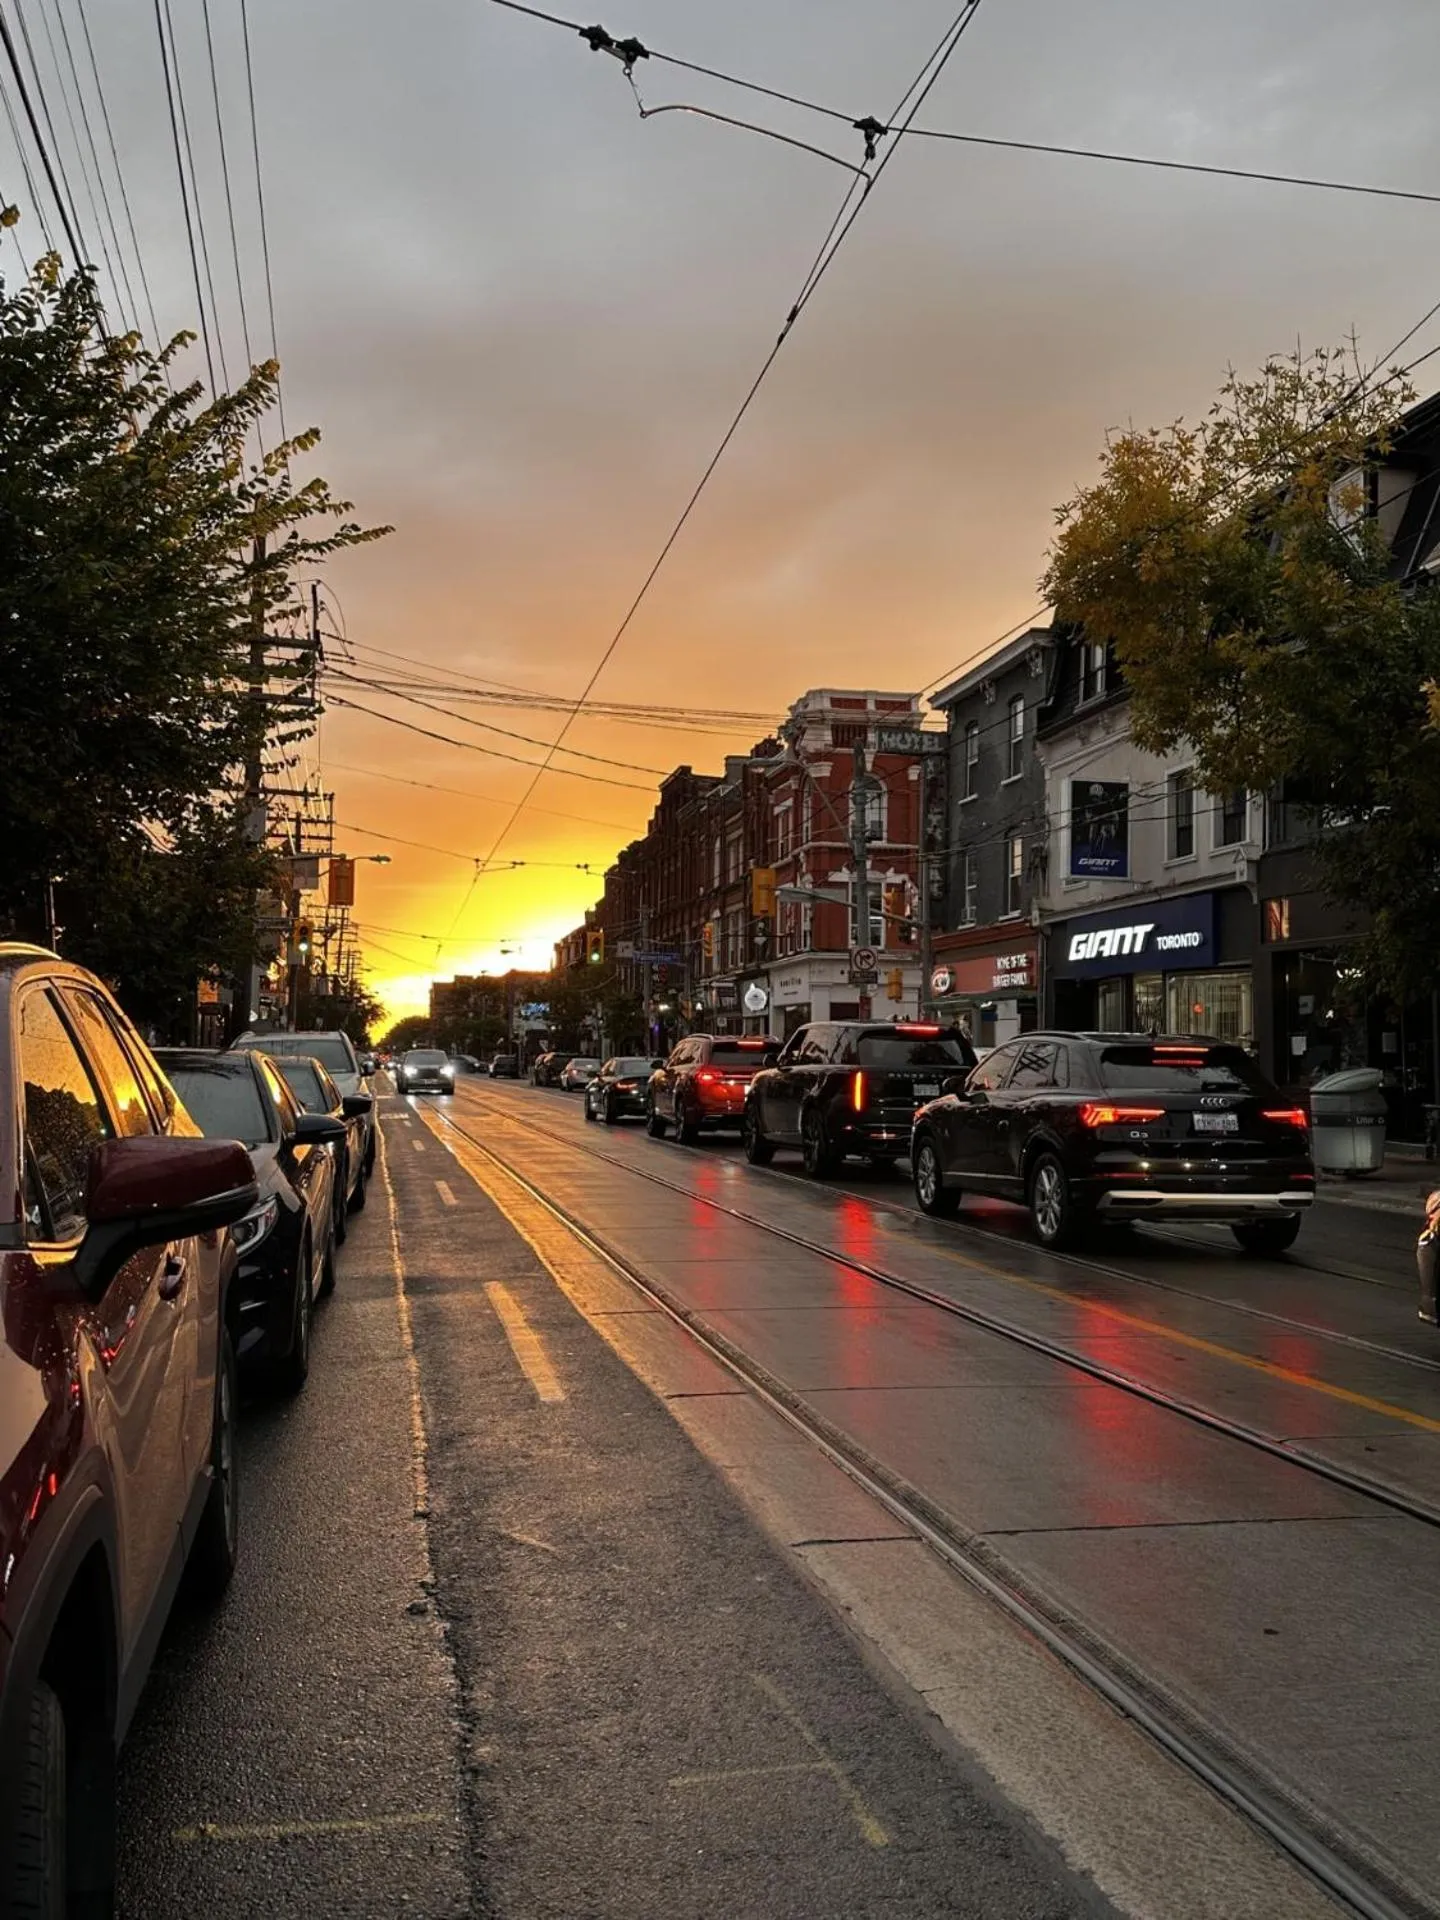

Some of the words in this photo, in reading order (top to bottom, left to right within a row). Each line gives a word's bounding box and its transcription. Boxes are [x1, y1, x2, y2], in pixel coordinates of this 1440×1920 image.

[881, 731, 944, 752] HOTEL
[1078, 858, 1120, 867] GIANT
[1068, 923, 1155, 961] GIANT
[1156, 931, 1201, 950] TORONTO
